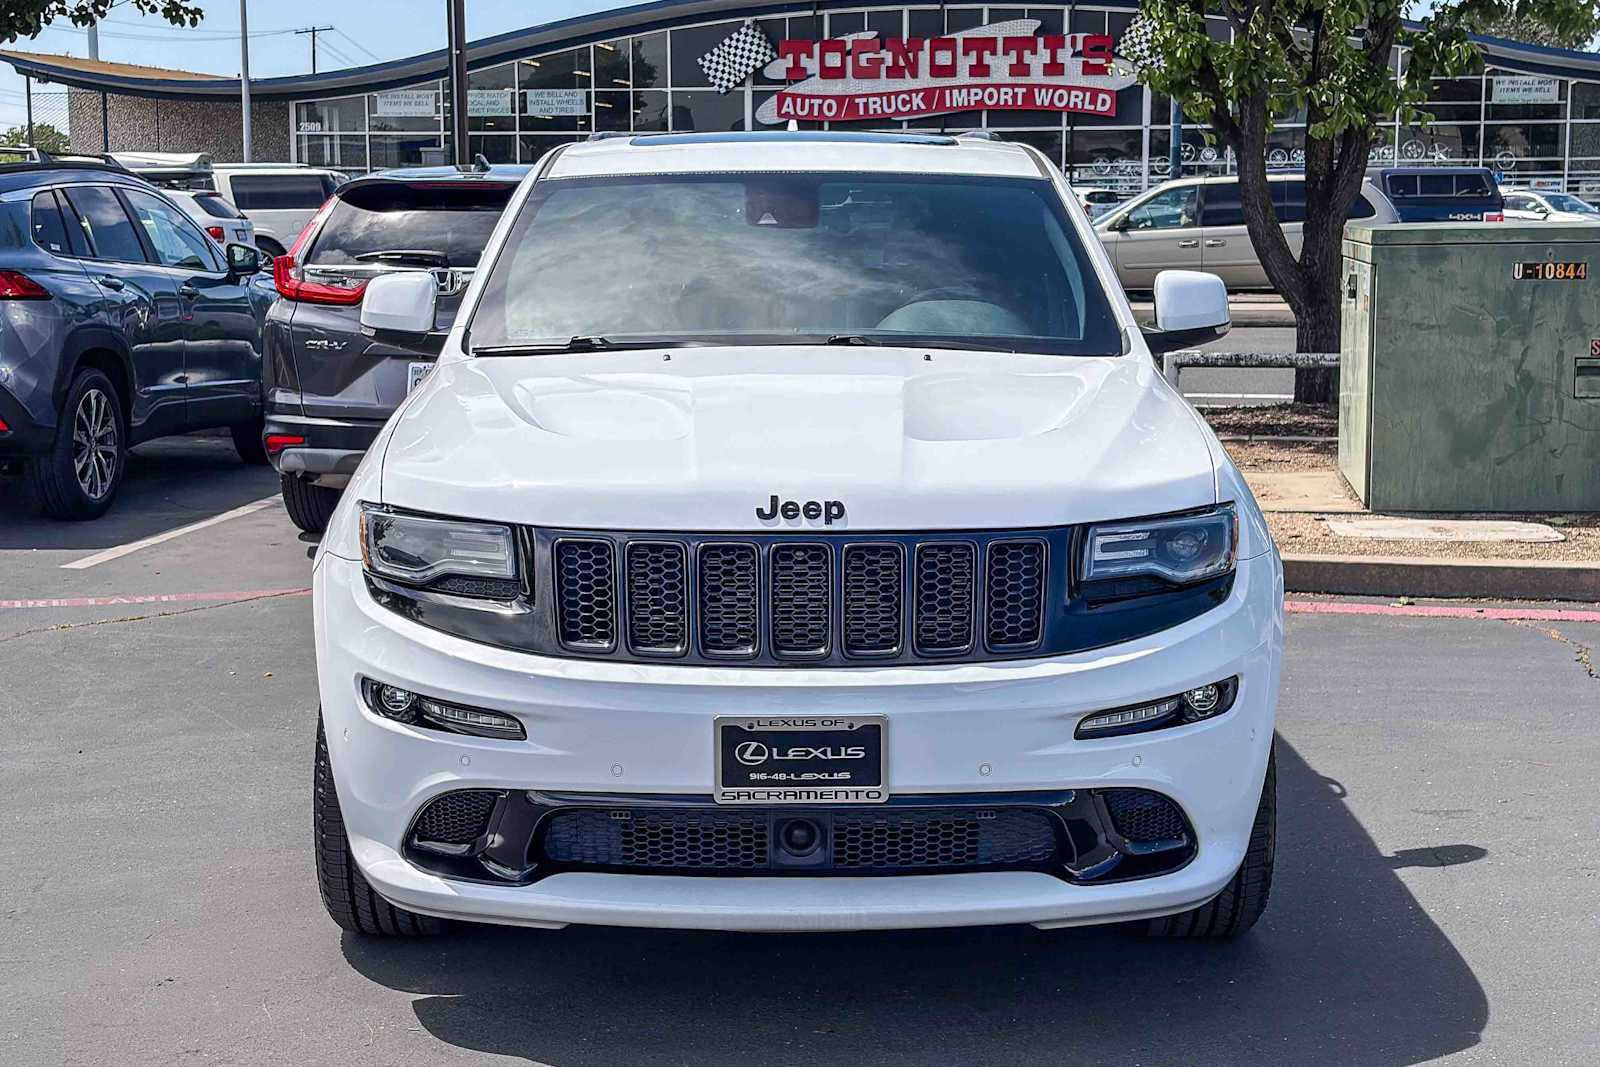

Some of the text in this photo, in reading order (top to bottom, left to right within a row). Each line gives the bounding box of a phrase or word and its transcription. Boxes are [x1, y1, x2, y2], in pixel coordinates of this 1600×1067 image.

[778, 34, 1114, 80] TOGNOTTI'S
[781, 96, 838, 117] AUTO
[855, 91, 927, 116] TRUCK
[945, 87, 1026, 108] IMPORT
[1034, 87, 1112, 112] WORLD
[305, 340, 348, 350] CR-V
[756, 494, 846, 526] Jeep
[757, 719, 845, 727] LEXUS OF
[772, 746, 866, 760] LEXUS
[749, 771, 851, 781] 916-48-LEXUS
[721, 790, 882, 801] SACRAMENTO
